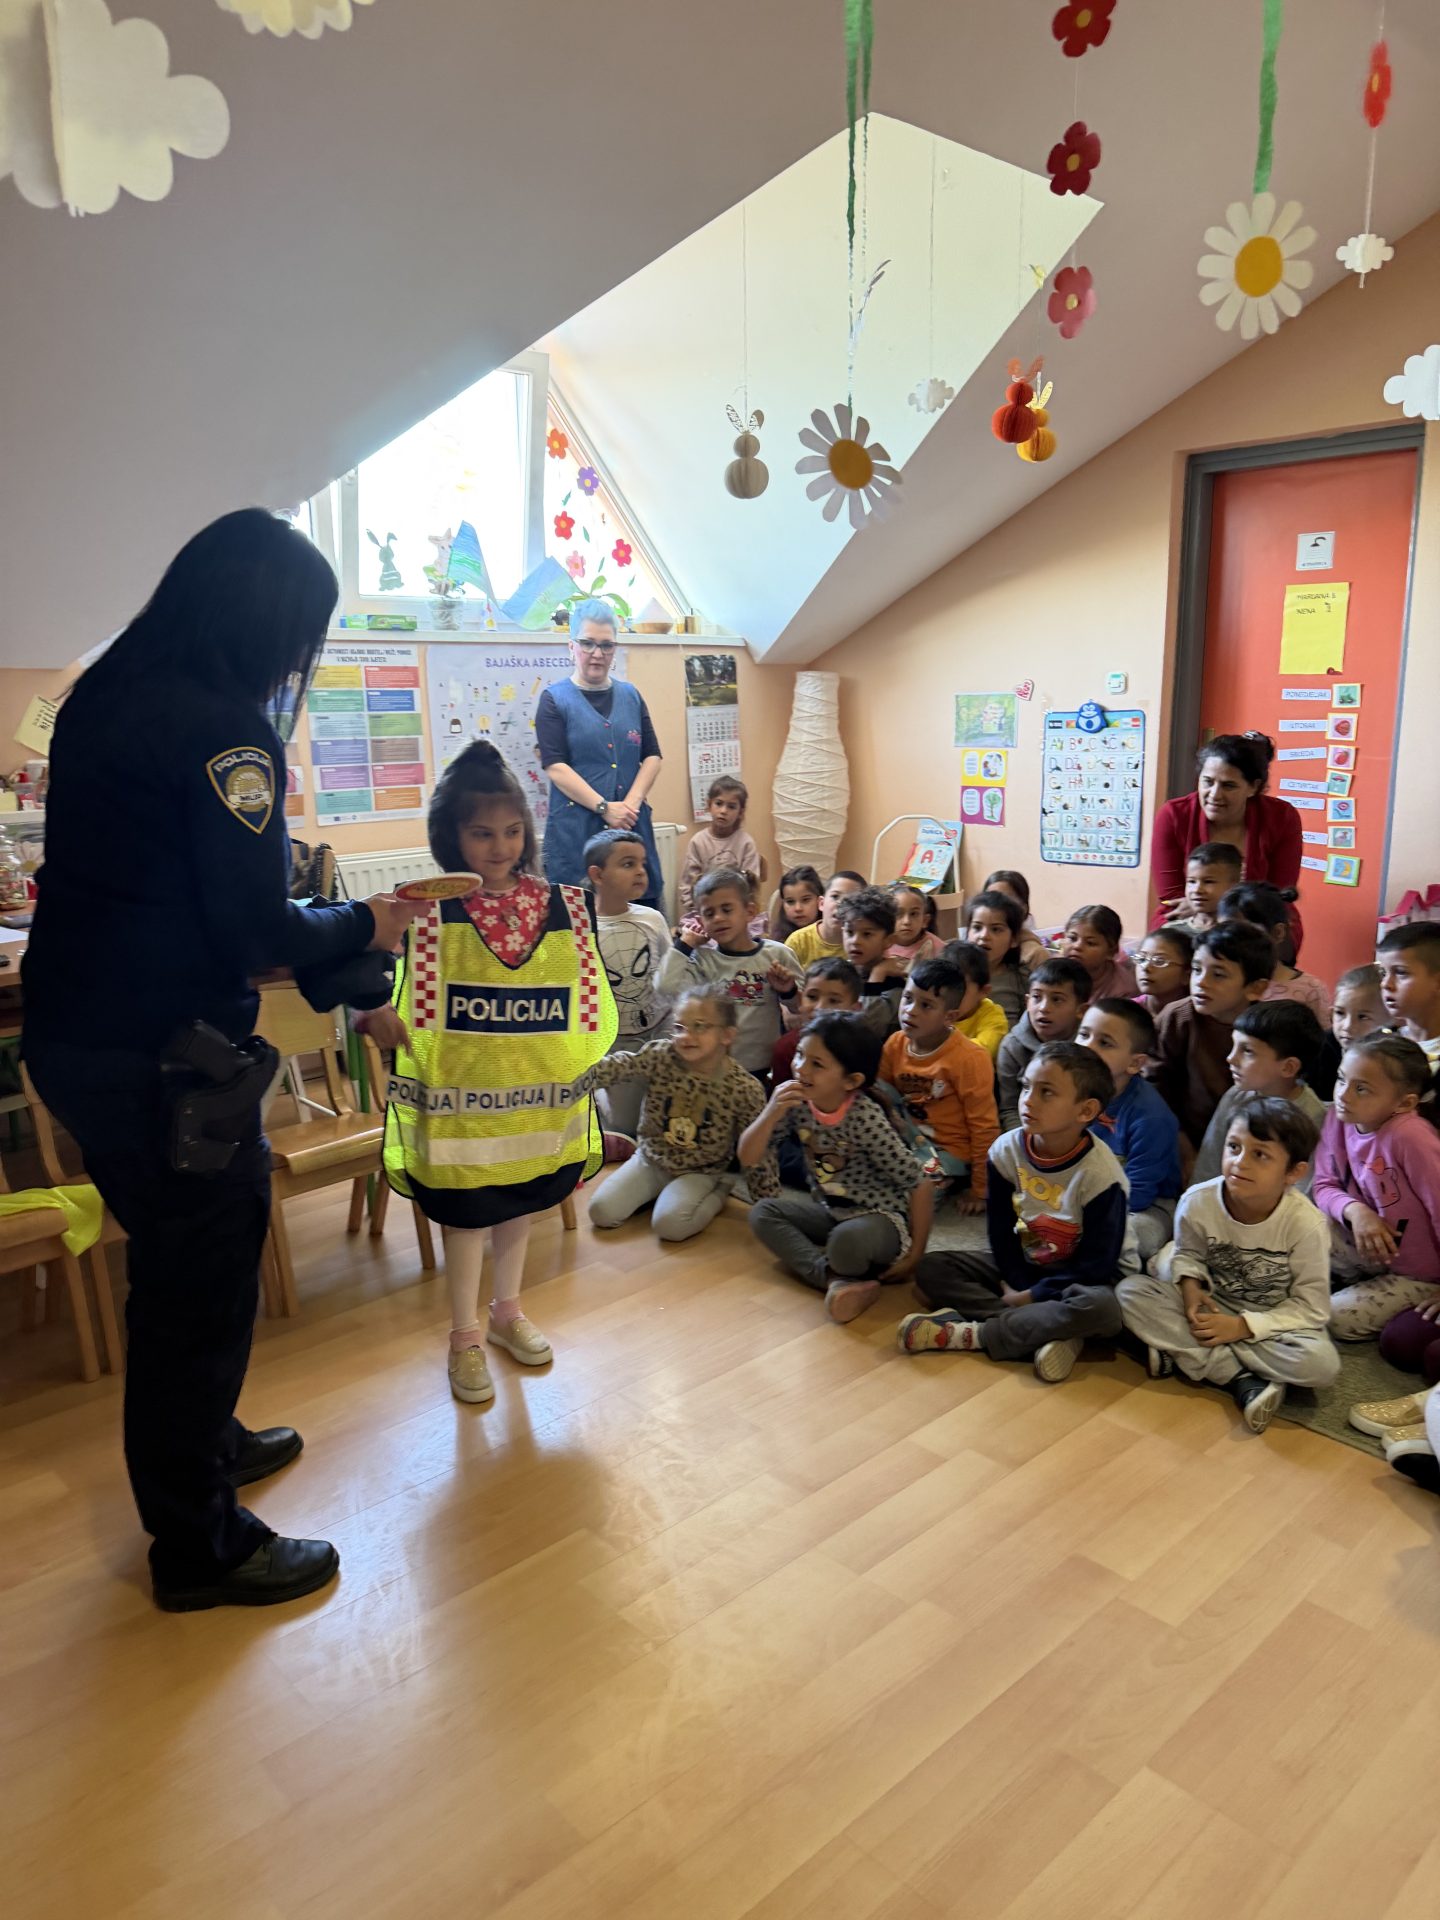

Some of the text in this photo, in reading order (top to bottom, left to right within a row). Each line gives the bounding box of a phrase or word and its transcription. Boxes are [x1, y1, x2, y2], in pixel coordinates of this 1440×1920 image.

[486, 655, 529, 668] BAJAŠKA
[920, 850, 934, 864] A
[451, 996, 565, 1021] POLICIJA
[466, 1088, 545, 1109] POLICIJA
